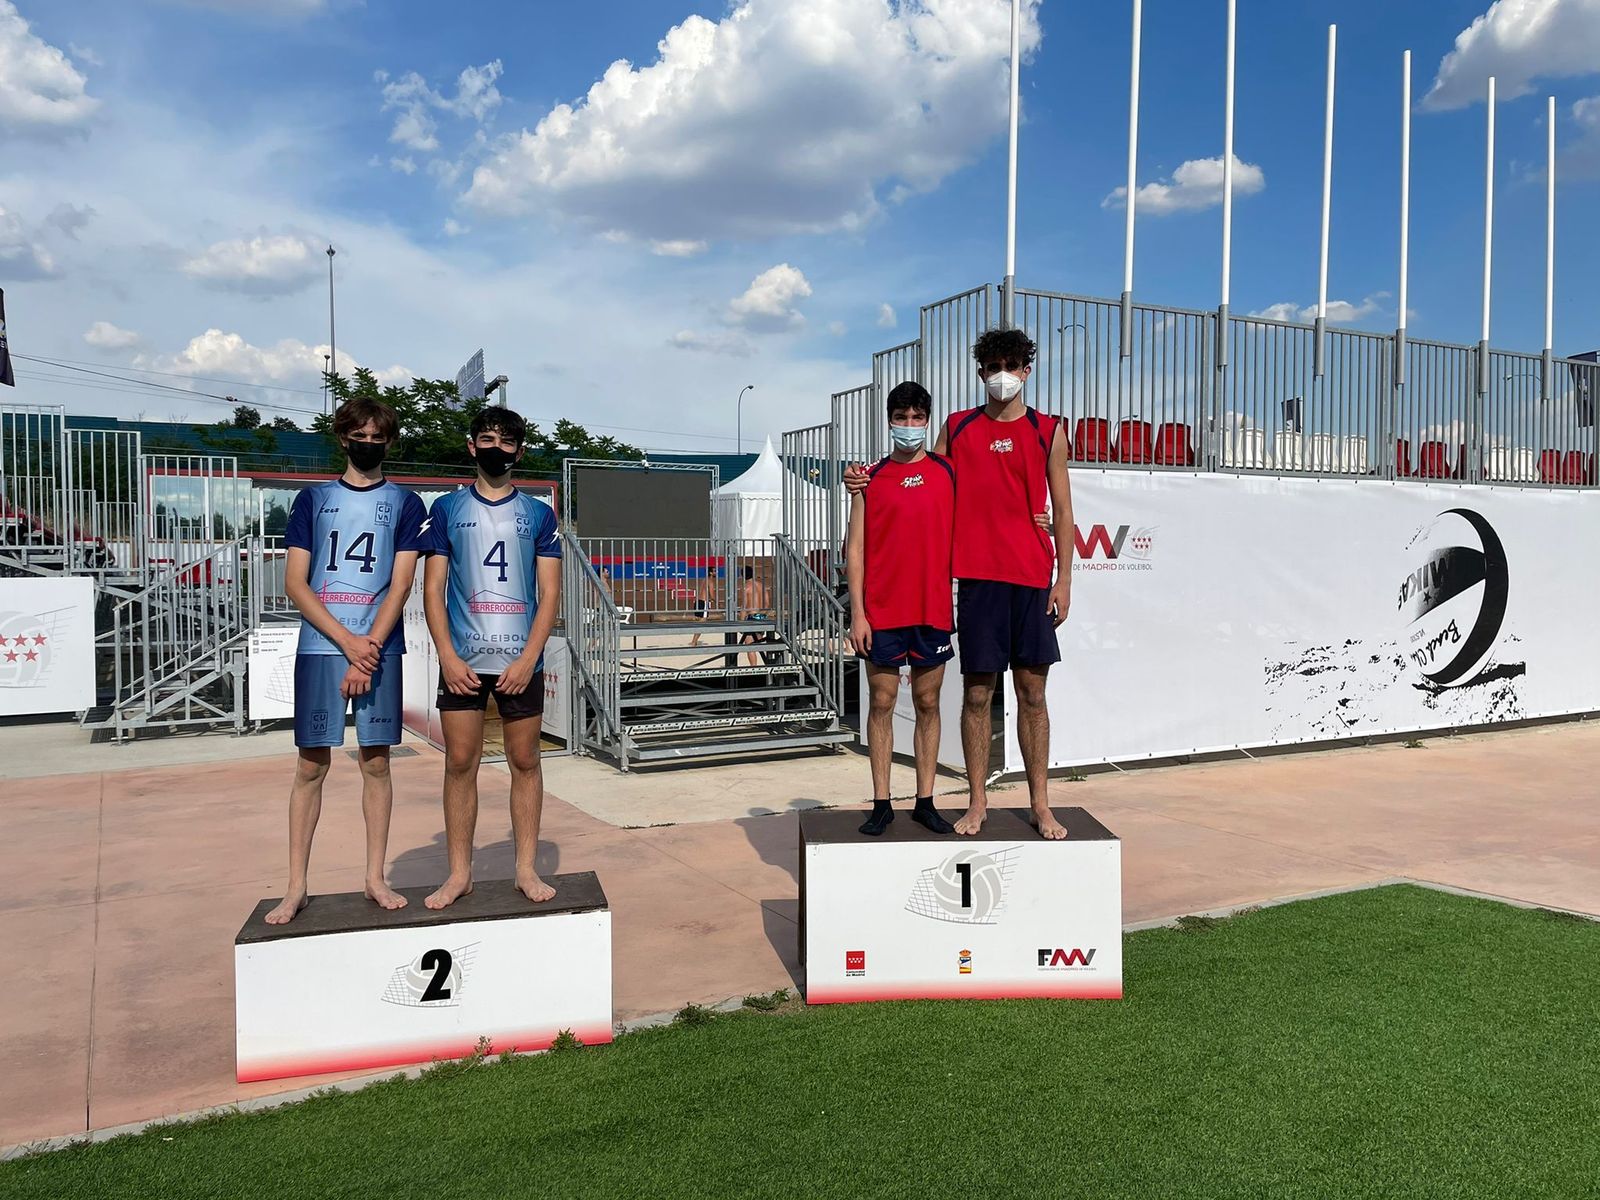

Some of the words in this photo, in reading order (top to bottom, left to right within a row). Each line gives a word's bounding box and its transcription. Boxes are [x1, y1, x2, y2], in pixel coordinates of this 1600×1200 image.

[325, 530, 379, 574] 14
[483, 541, 508, 582] 4
[1082, 563, 1118, 571] MADRID
[1118, 563, 1126, 571] DE
[465, 632, 529, 642] VOLEIBOL
[956, 863, 972, 908] 1
[420, 948, 453, 1002] 2
